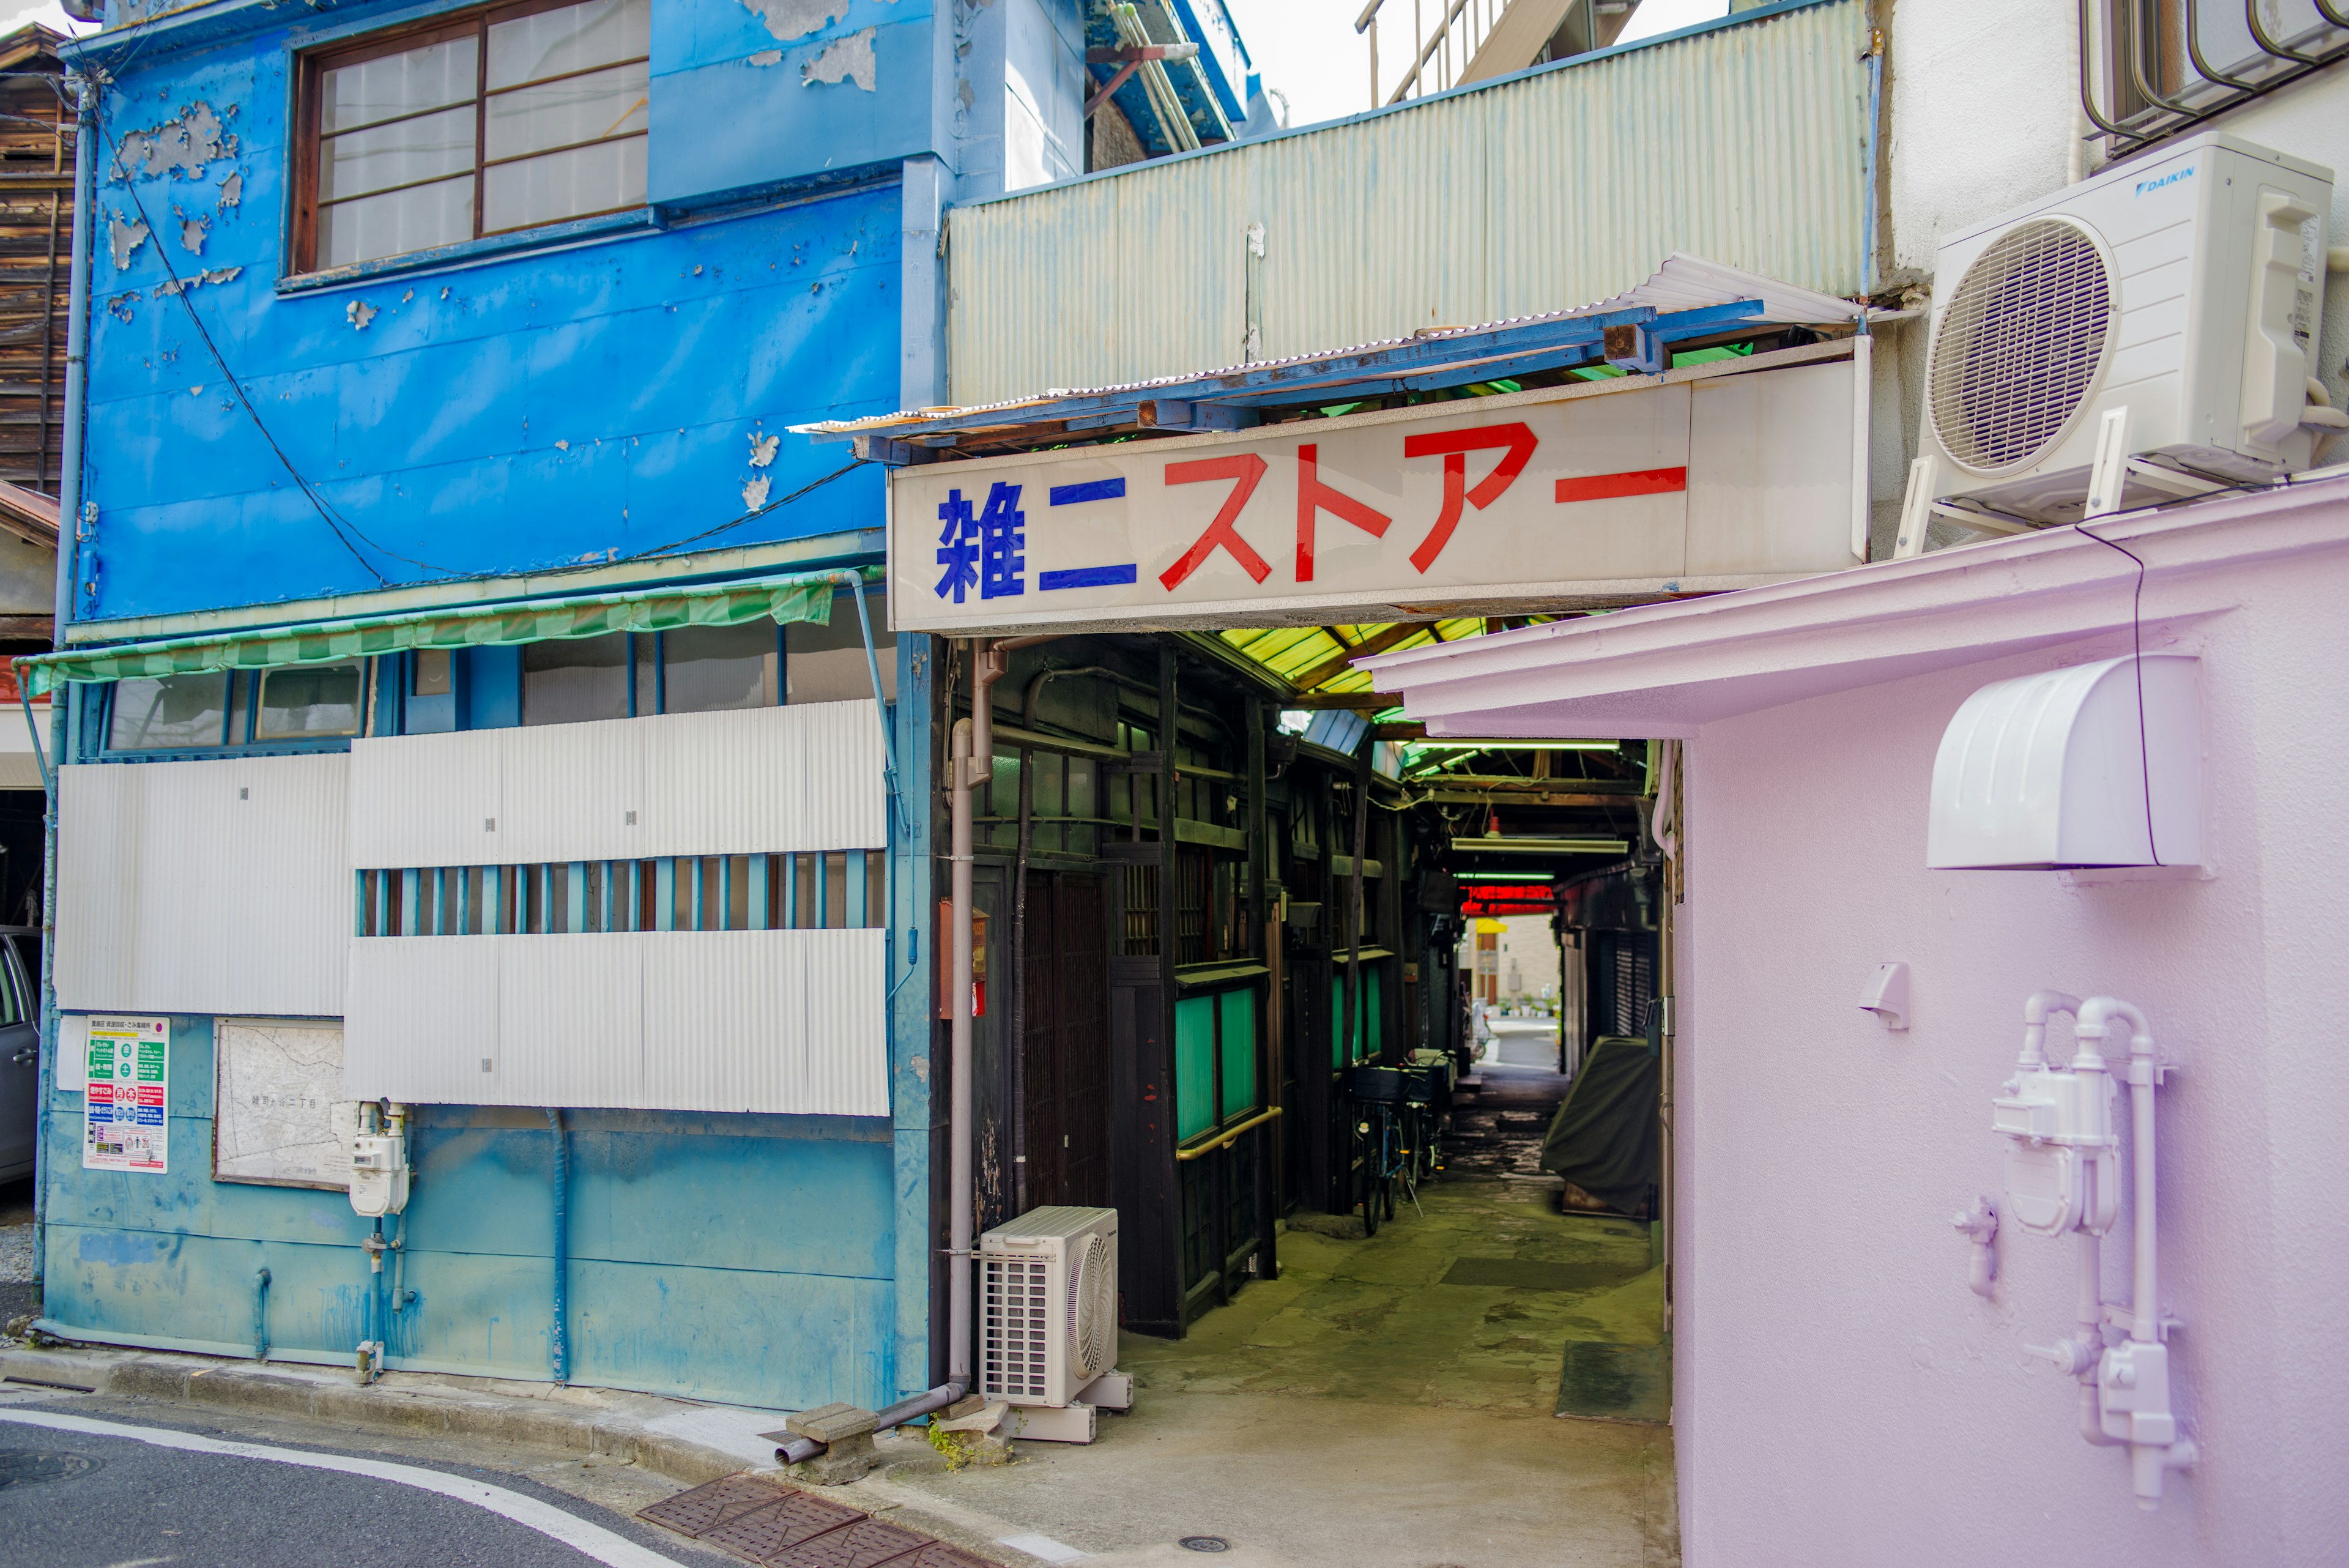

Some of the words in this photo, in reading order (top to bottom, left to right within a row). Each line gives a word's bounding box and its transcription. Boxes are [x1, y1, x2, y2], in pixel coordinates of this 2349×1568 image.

[2148, 166, 2194, 192] DAIKIN
[935, 422, 1687, 603] 雑二ストアー
[122, 1065, 129, 1073] 土
